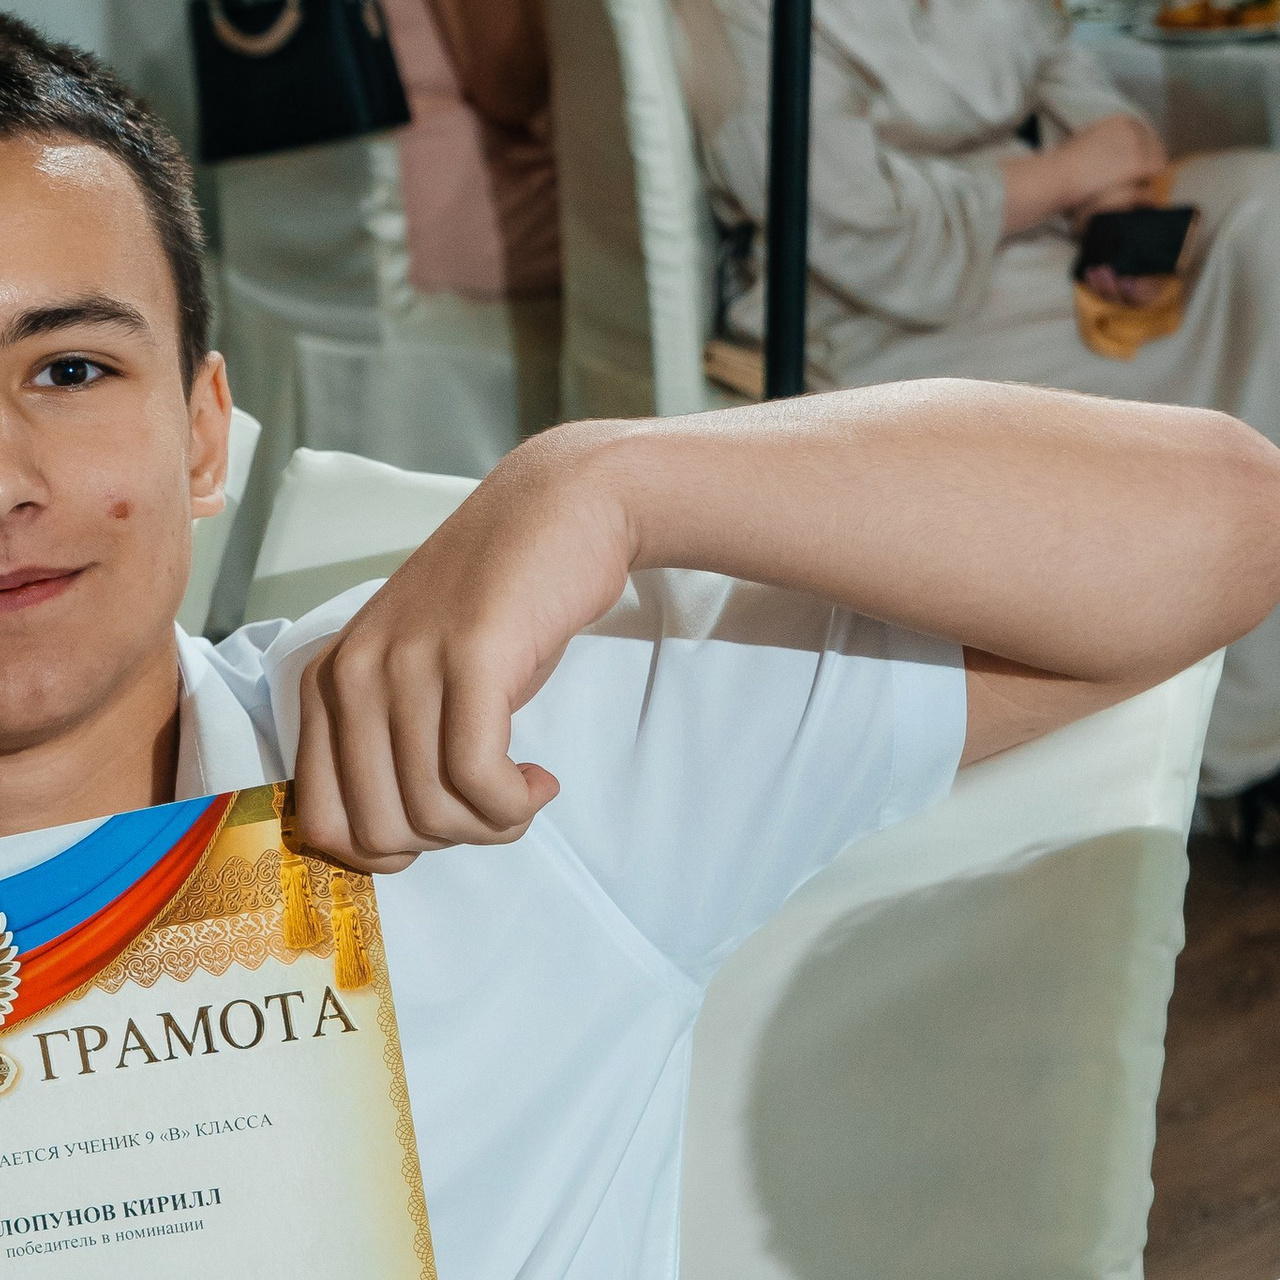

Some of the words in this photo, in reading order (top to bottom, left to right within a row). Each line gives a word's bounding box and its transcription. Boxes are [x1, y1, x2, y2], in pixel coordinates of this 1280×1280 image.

[32, 985, 359, 1082] ГРАМОТА
[64, 1132, 141, 1158] УЧЕНИК
[144, 1130, 156, 1145] 9
[159, 1126, 192, 1143] «В»
[195, 1113, 274, 1138] КЛАССА
[122, 1187, 222, 1219] КИРИЛЛ
[6, 1234, 98, 1259] победитель
[101, 1233, 111, 1244] в
[115, 1219, 205, 1243] номинации
